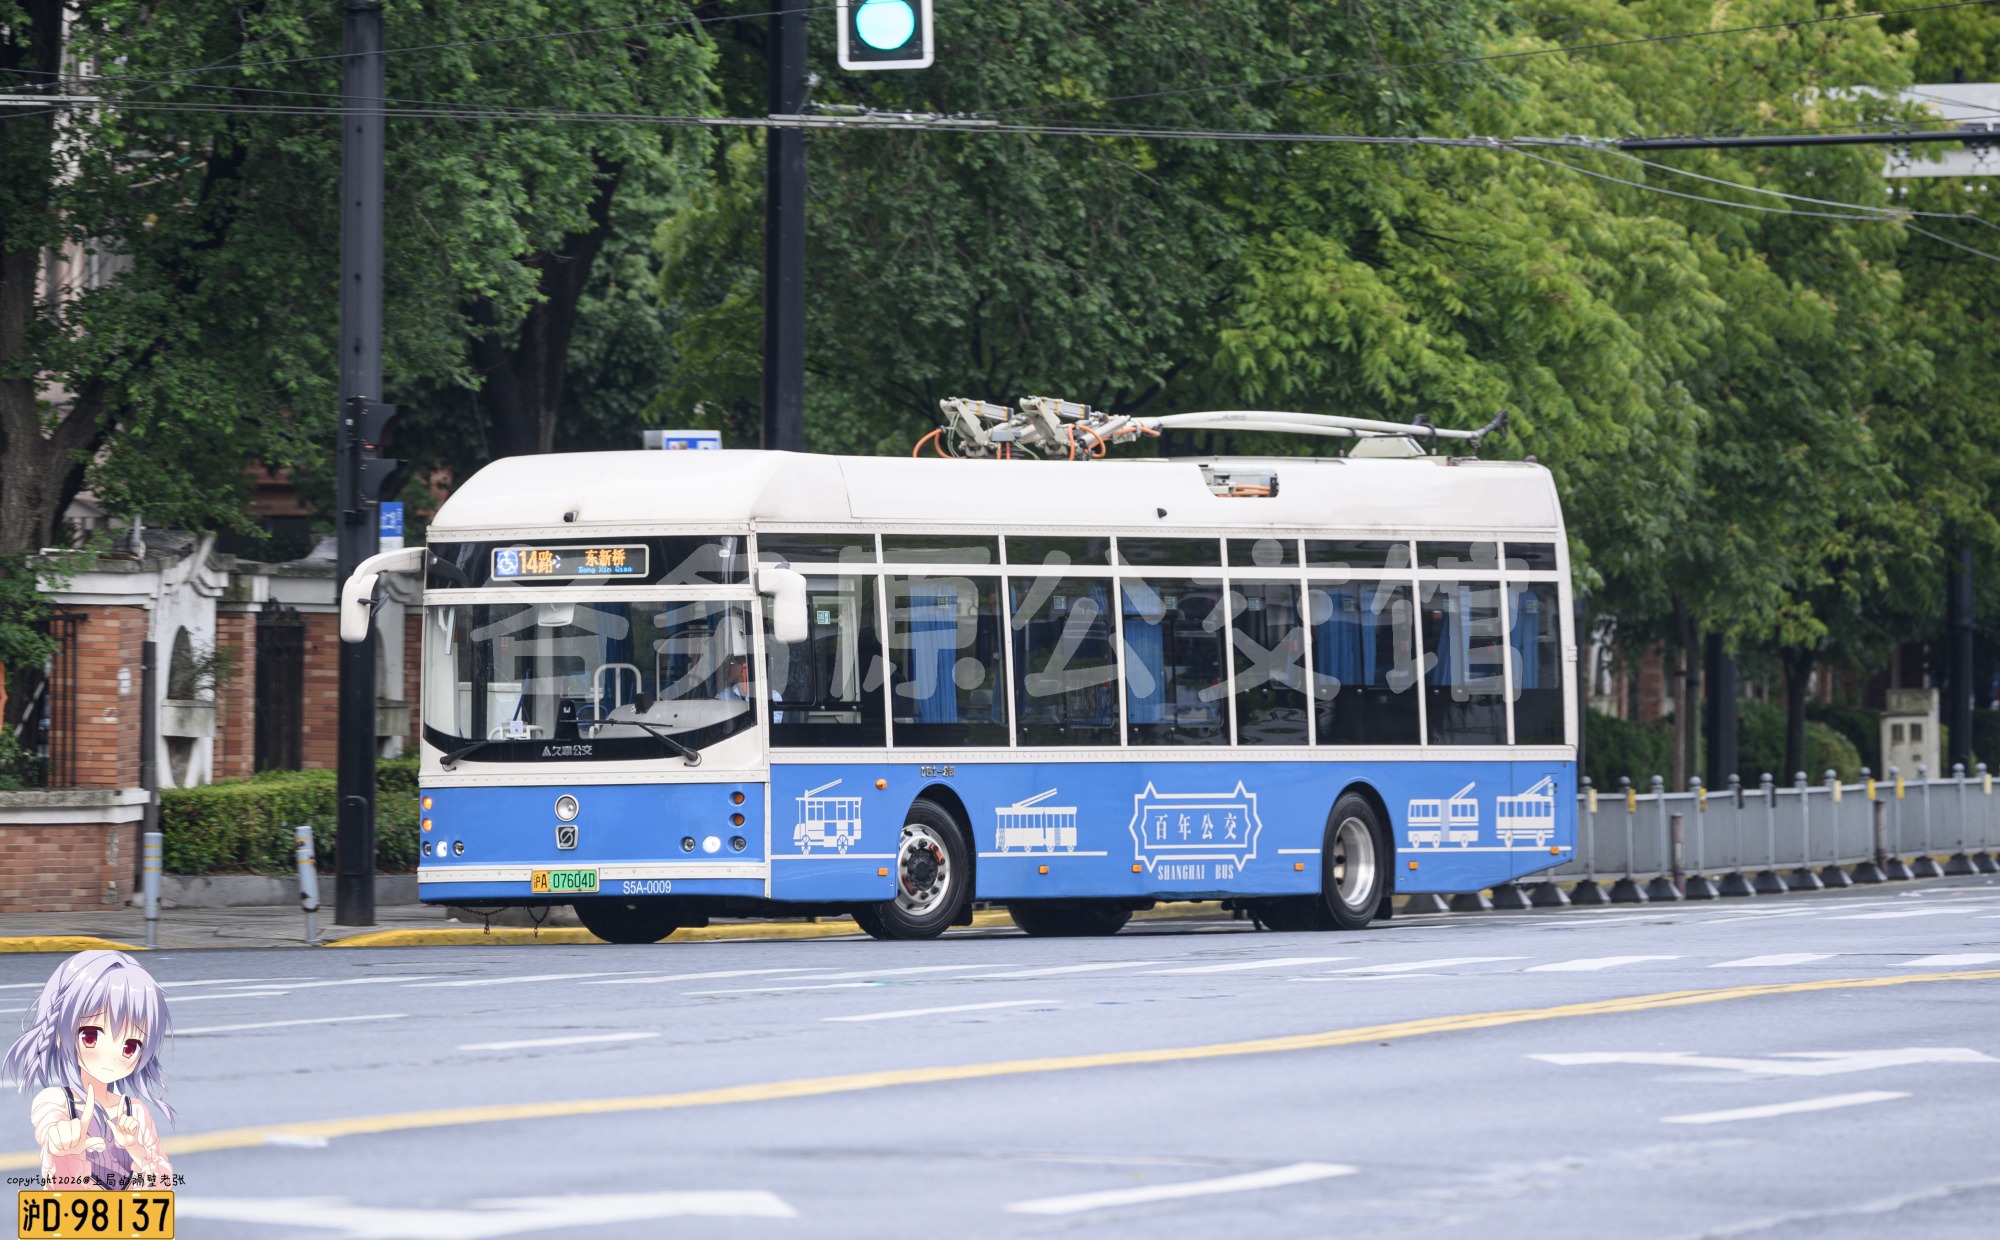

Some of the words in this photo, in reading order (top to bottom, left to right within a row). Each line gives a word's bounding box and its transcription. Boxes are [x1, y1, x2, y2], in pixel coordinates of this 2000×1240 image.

[519, 550, 554, 574] 14路
[585, 549, 626, 567] 东新桥
[598, 565, 612, 573] Xin
[1154, 812, 1238, 841] 百年公交
[1157, 864, 1205, 881] SHANGHAI
[1214, 864, 1234, 880] BUS
[622, 880, 672, 895] S5A-0009
